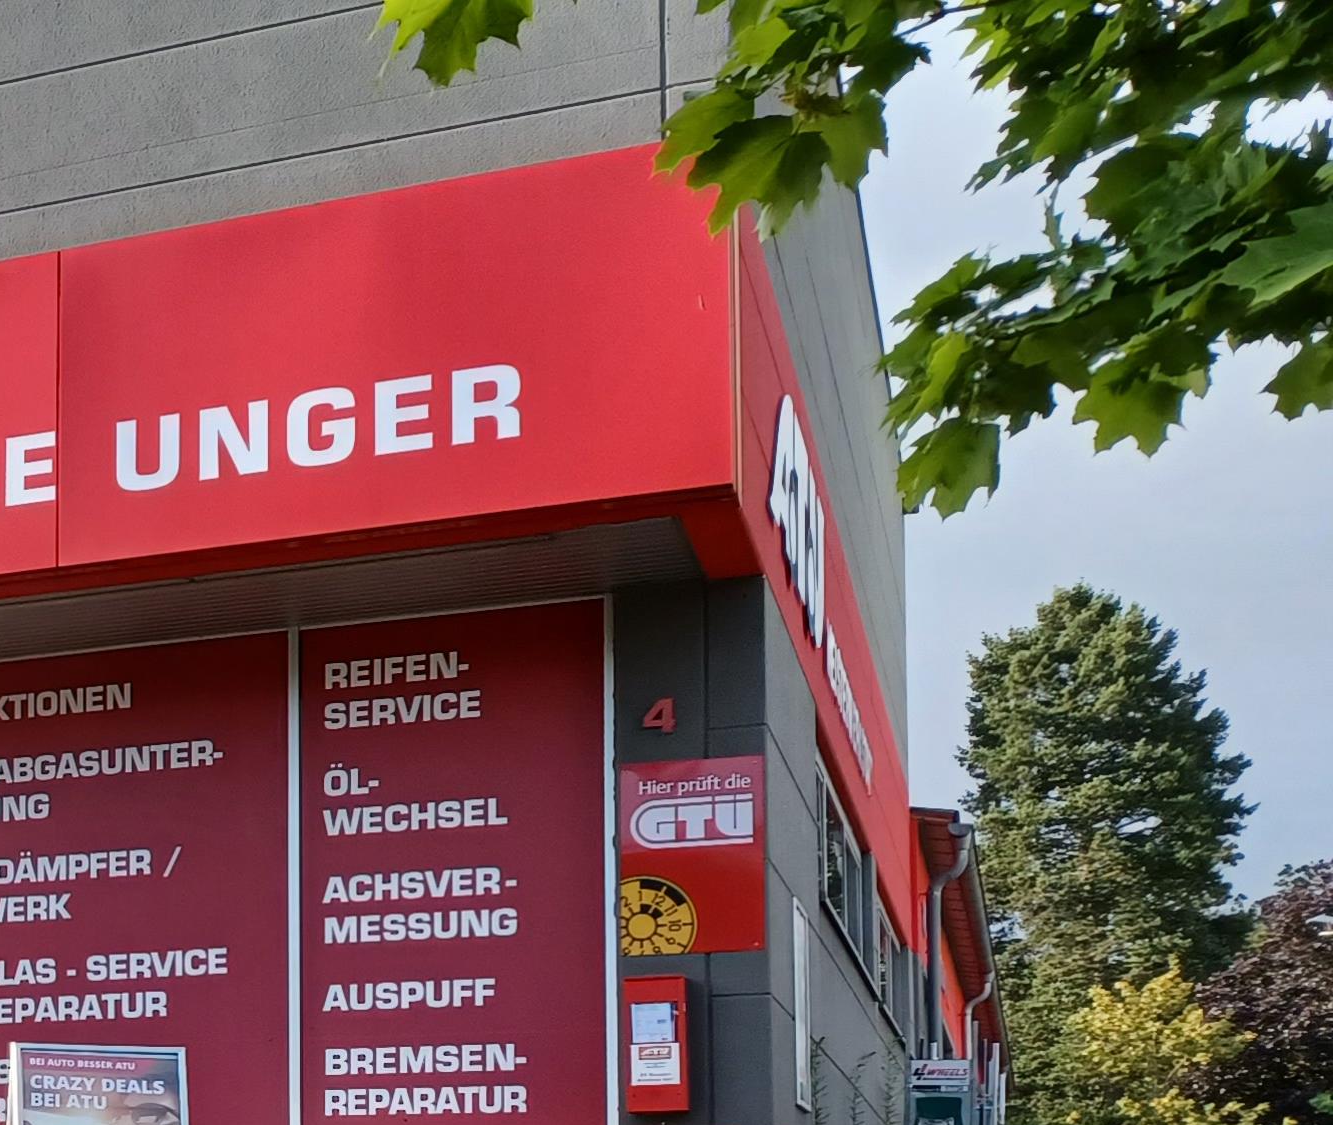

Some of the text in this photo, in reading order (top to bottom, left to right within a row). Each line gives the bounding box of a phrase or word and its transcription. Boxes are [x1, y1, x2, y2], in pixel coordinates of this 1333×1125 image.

[115, 364, 521, 492] UNGER
[324, 651, 469, 689] REIFEN-
[324, 690, 481, 730] SERVICE
[643, 697, 676, 734] 4
[323, 762, 379, 797] ÖL-
[638, 773, 751, 796] Hier prüft die
[323, 797, 508, 836] WECHSEL
[163, 846, 182, 877] /
[322, 866, 517, 904] ACHSVER-
[324, 907, 518, 944] MESSUNG
[86, 947, 228, 981] SERVICE
[322, 978, 496, 1012] AUSPUFF
[30, 1057, 135, 1070] BEI AUTO BESSER ATU
[325, 1043, 527, 1076] BREMSEN-
[30, 1075, 165, 1095] CRAZY DEALS
[31, 1092, 108, 1110] BEI ATU
[325, 1085, 527, 1116] REPARATUR
